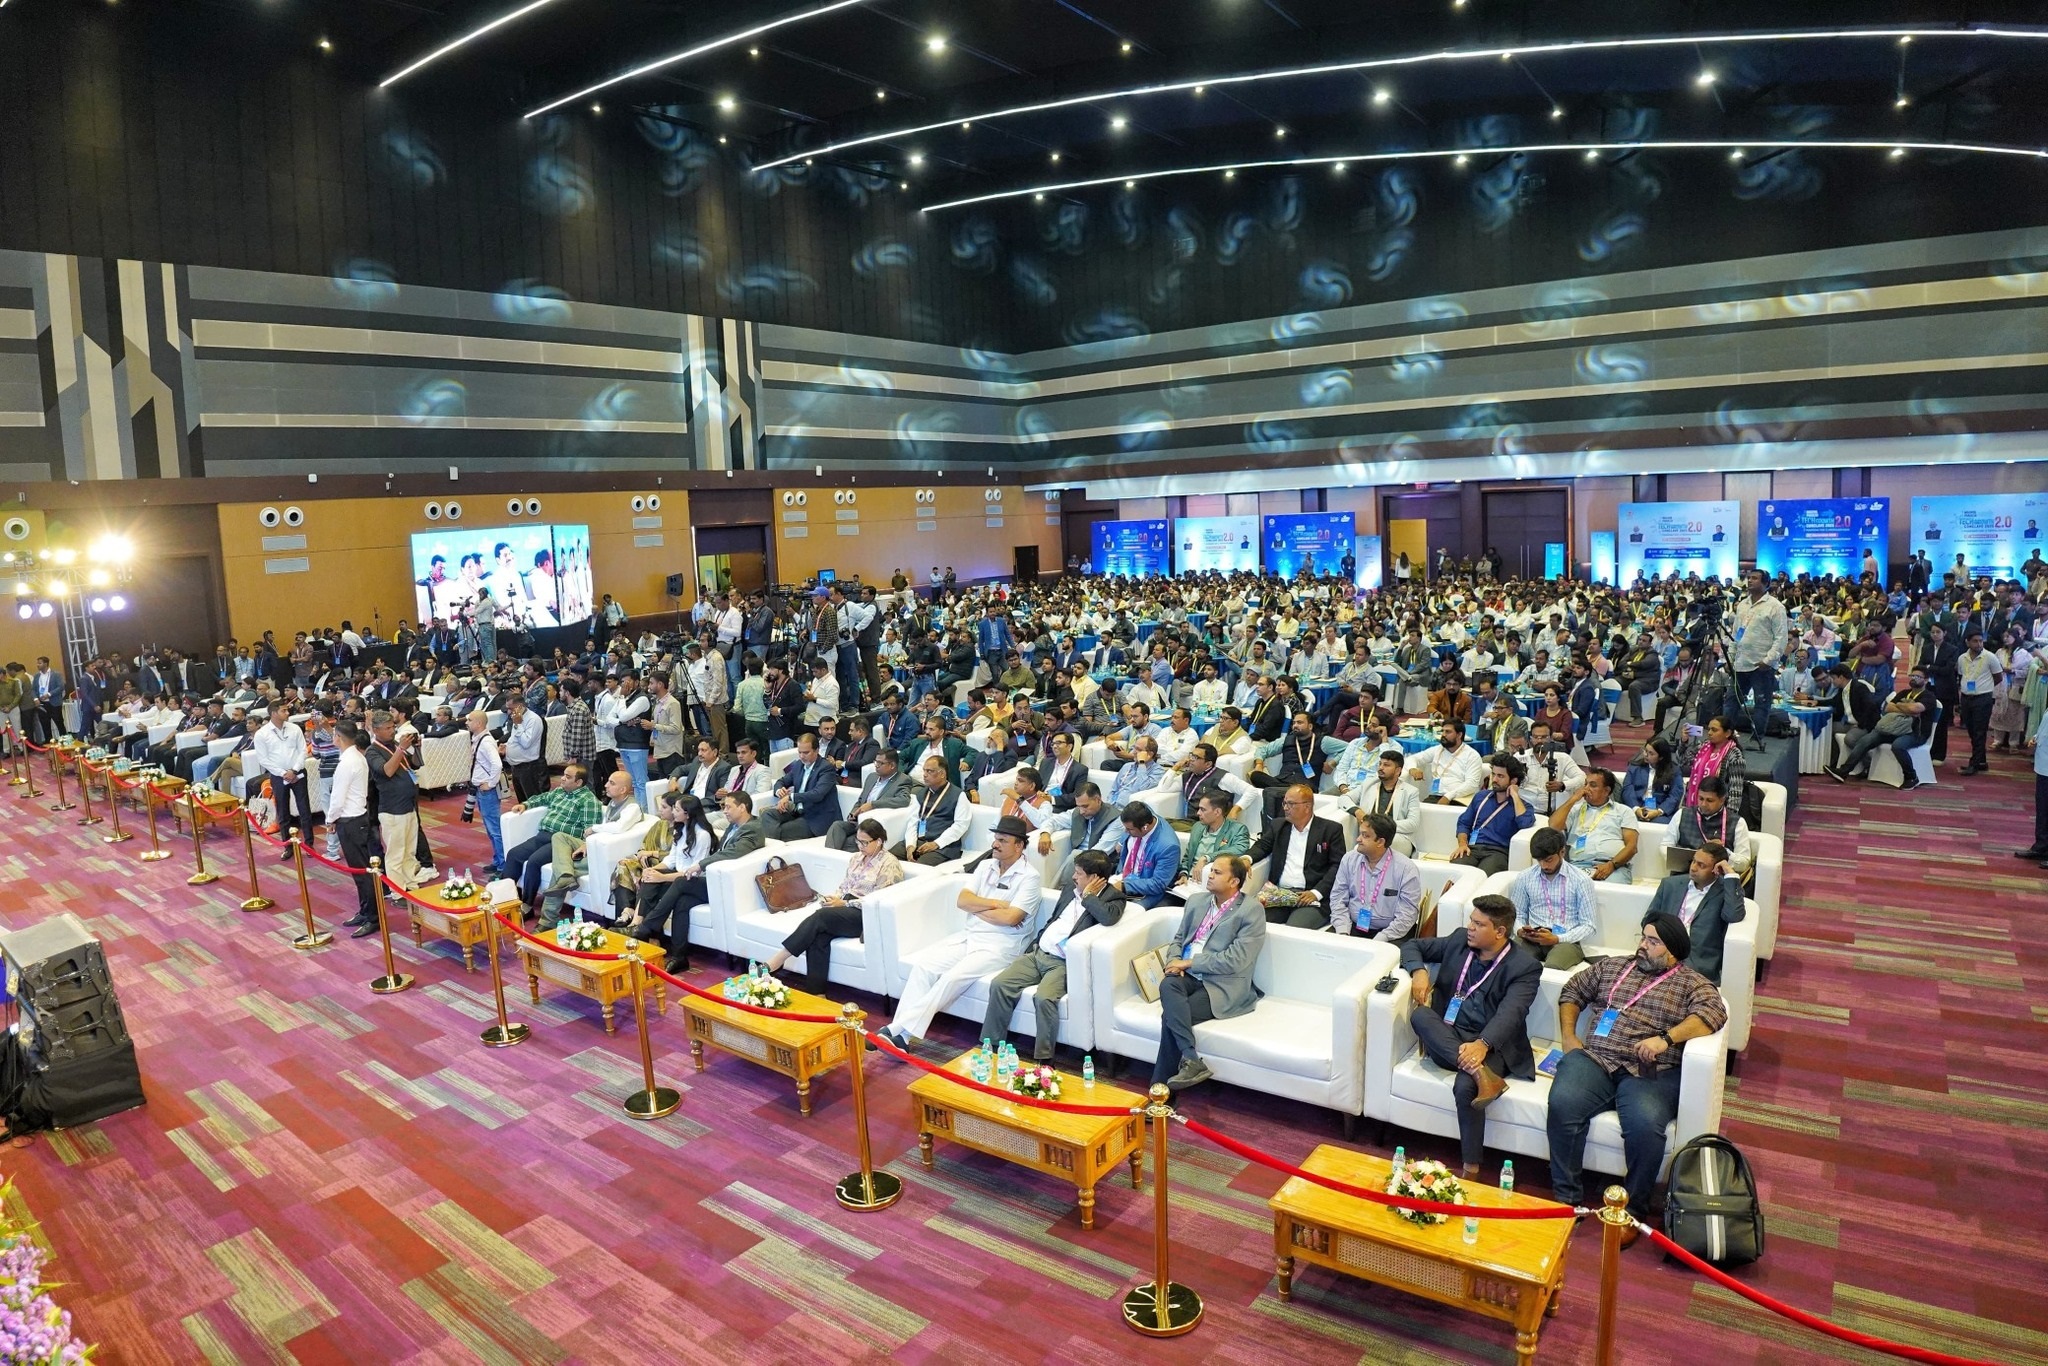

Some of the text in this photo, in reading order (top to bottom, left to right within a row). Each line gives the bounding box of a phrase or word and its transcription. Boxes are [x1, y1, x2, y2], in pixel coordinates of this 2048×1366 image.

[1688, 521, 1703, 533] 2.0
[1835, 515, 1851, 528] 2.0
[1995, 515, 2012, 528] 2.0
[1223, 532, 1234, 542] 2.0
[1317, 529, 1330, 540] 2.0
